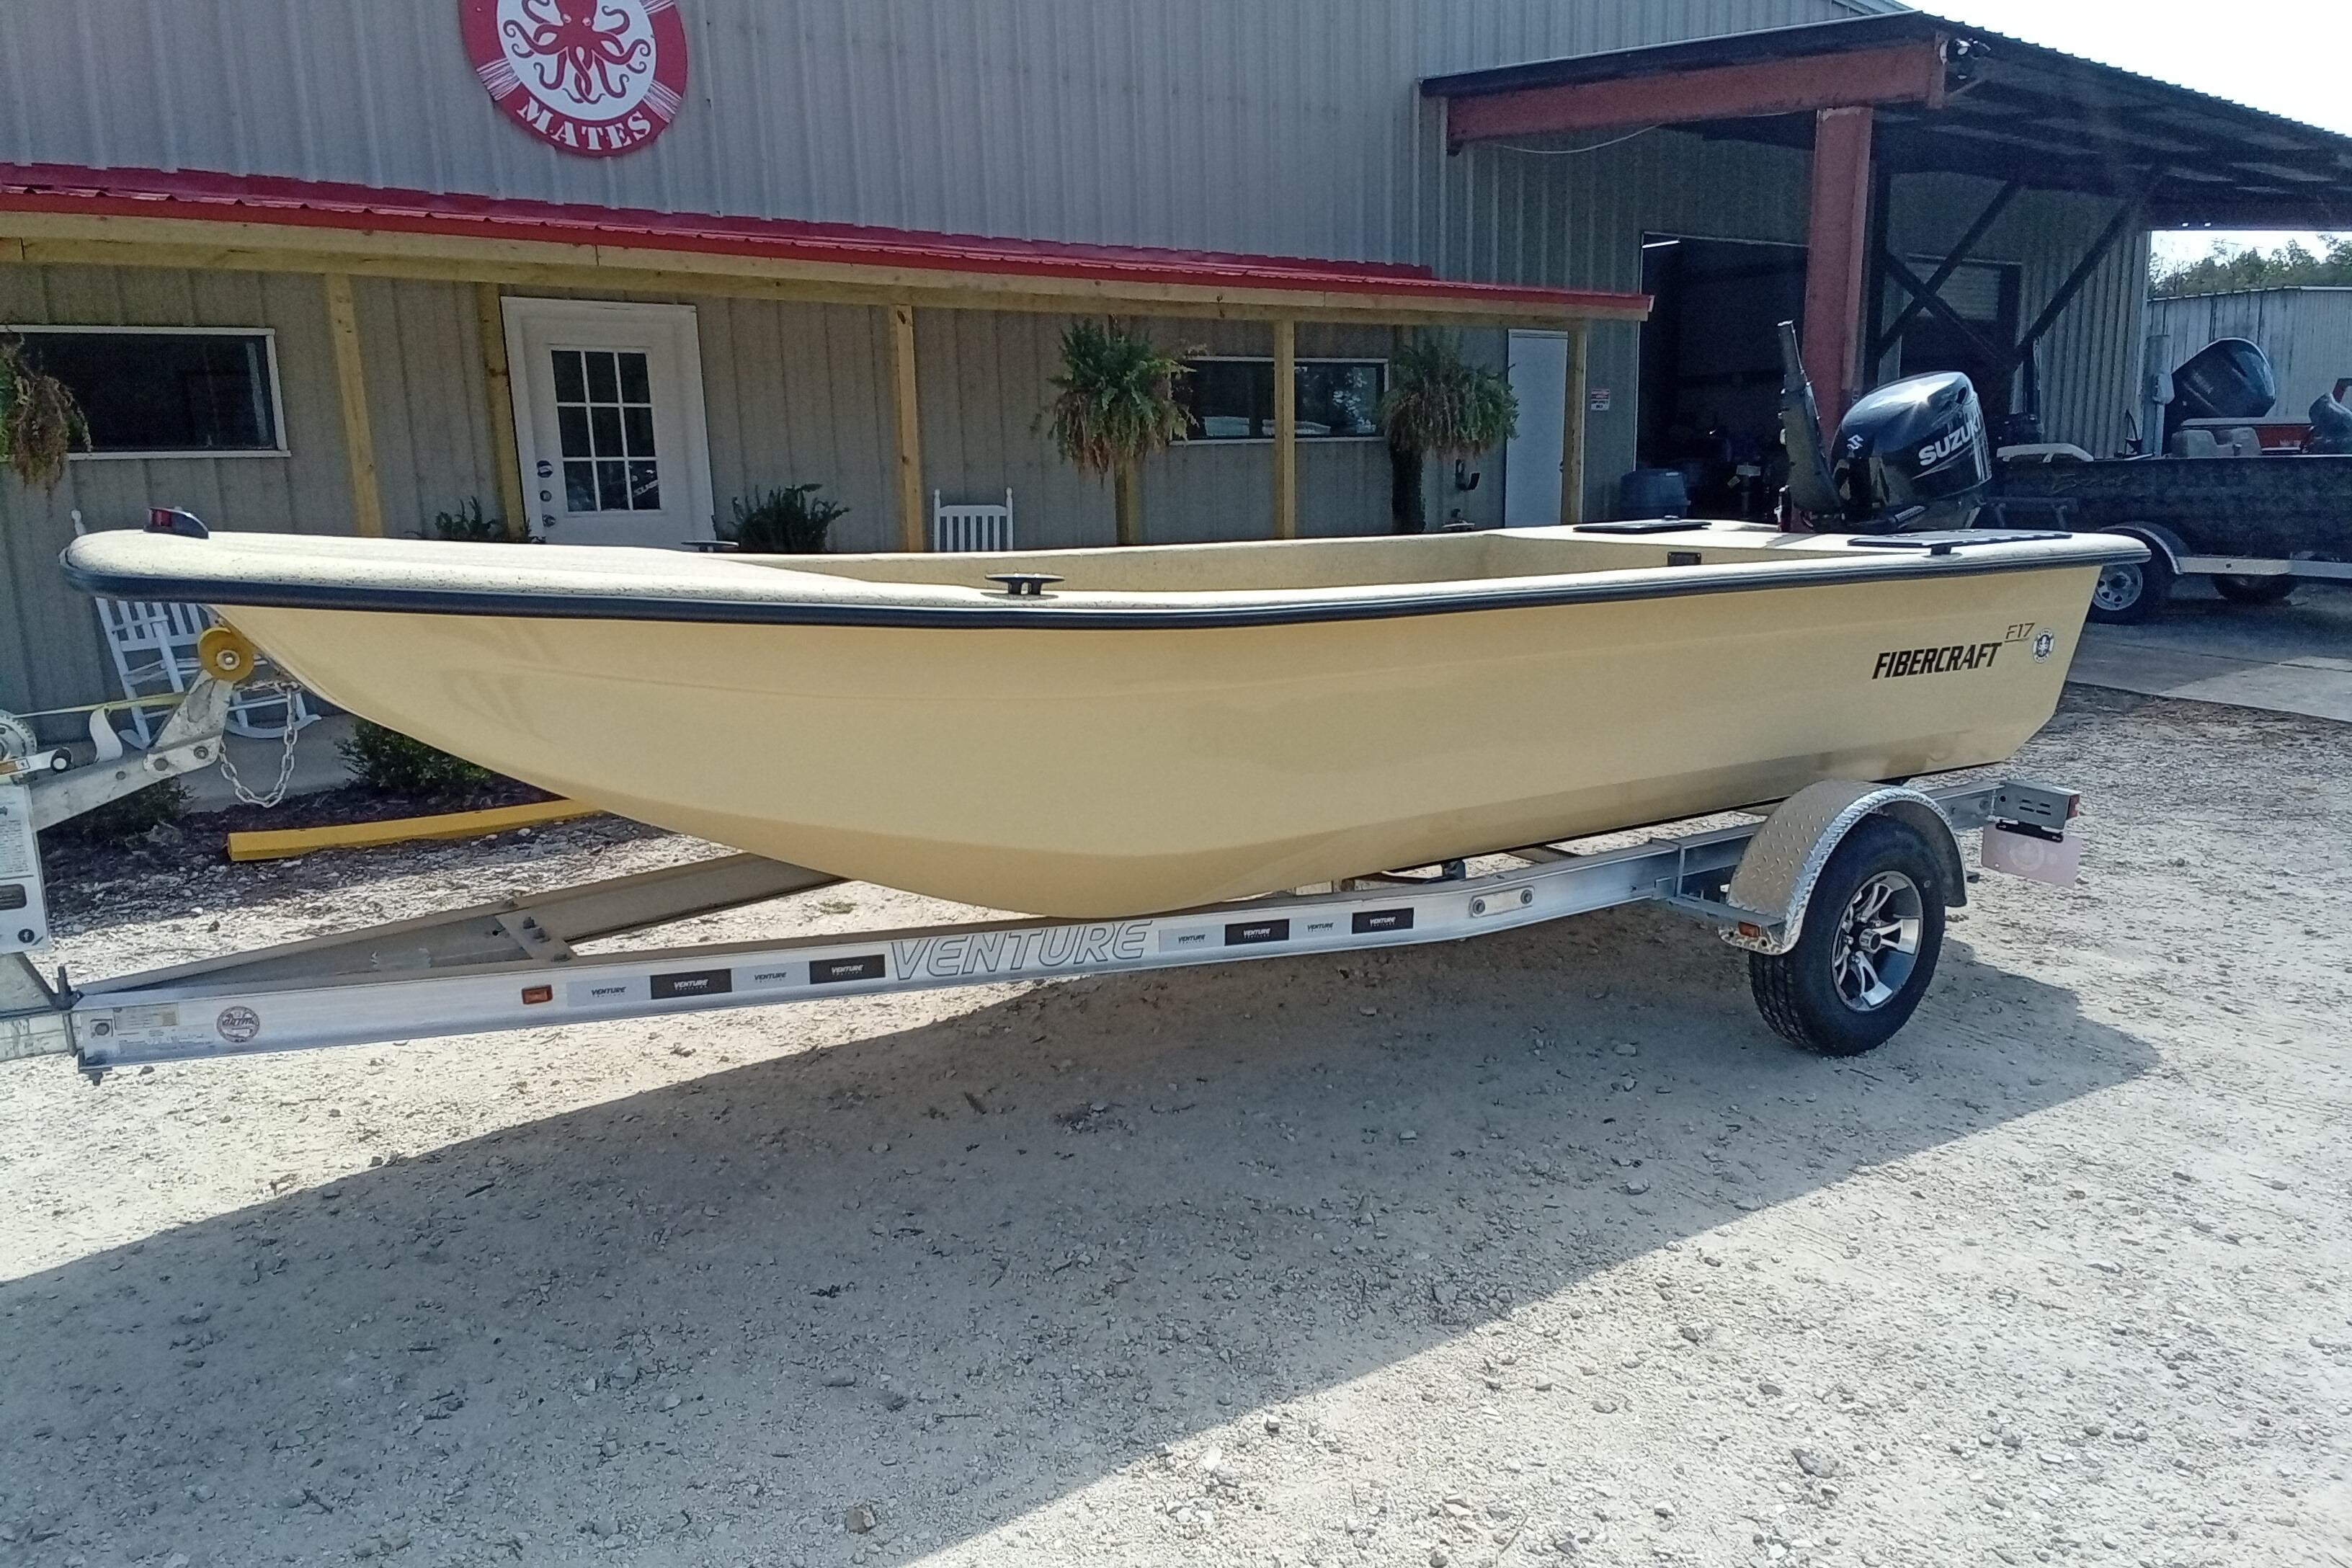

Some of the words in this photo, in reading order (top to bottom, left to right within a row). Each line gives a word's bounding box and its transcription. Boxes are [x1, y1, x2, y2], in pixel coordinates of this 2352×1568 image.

[516, 97, 652, 151] MATES
[1918, 415, 1981, 466] SUZUKI
[2005, 623, 2035, 639] F17
[1871, 642, 2003, 680] FIBERCRAFT
[1307, 922, 1335, 932] VENTURE
[1370, 916, 1396, 927] VENTURE
[1243, 927, 1271, 938] VENTURE
[1178, 934, 1206, 943] VENTURE
[891, 919, 1154, 981] VENTURE
[831, 964, 865, 975] VENTURE
[754, 972, 788, 981] VENTURE
[673, 979, 709, 991] VENTURE
[591, 986, 627, 997] VENTURE
